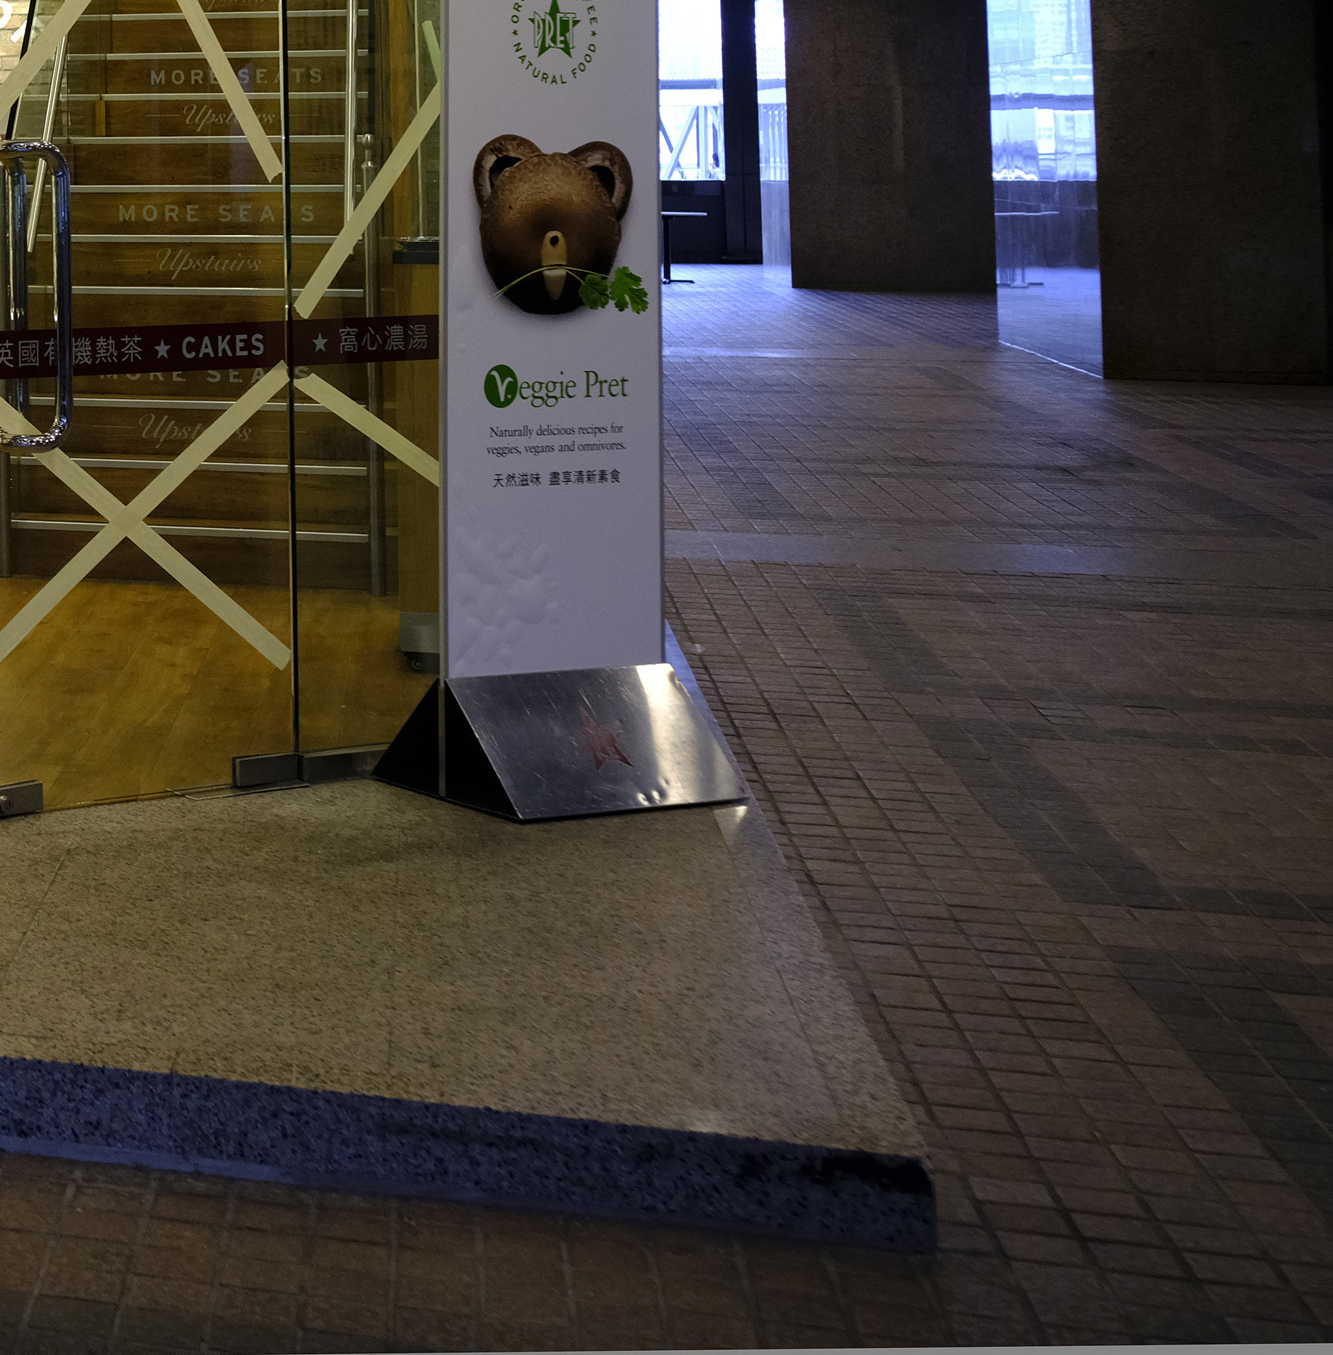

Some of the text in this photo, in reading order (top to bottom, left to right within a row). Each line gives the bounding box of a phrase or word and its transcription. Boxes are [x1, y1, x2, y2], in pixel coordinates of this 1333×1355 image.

[533, 10, 577, 49] PRET
[513, 41, 597, 85] NATURAL FOOD
[118, 204, 314, 223] MORE SEAS
[155, 246, 262, 280] Upstairs
[181, 332, 265, 359] CAKES
[338, 323, 430, 355] 窩心濃湯
[484, 364, 629, 409] Veggie Pret
[489, 421, 624, 439] Naturally delicious recipes for
[486, 440, 626, 458] veggies, vegans and omnivores.
[493, 468, 621, 488] 天然滋味 盡享清新素食
